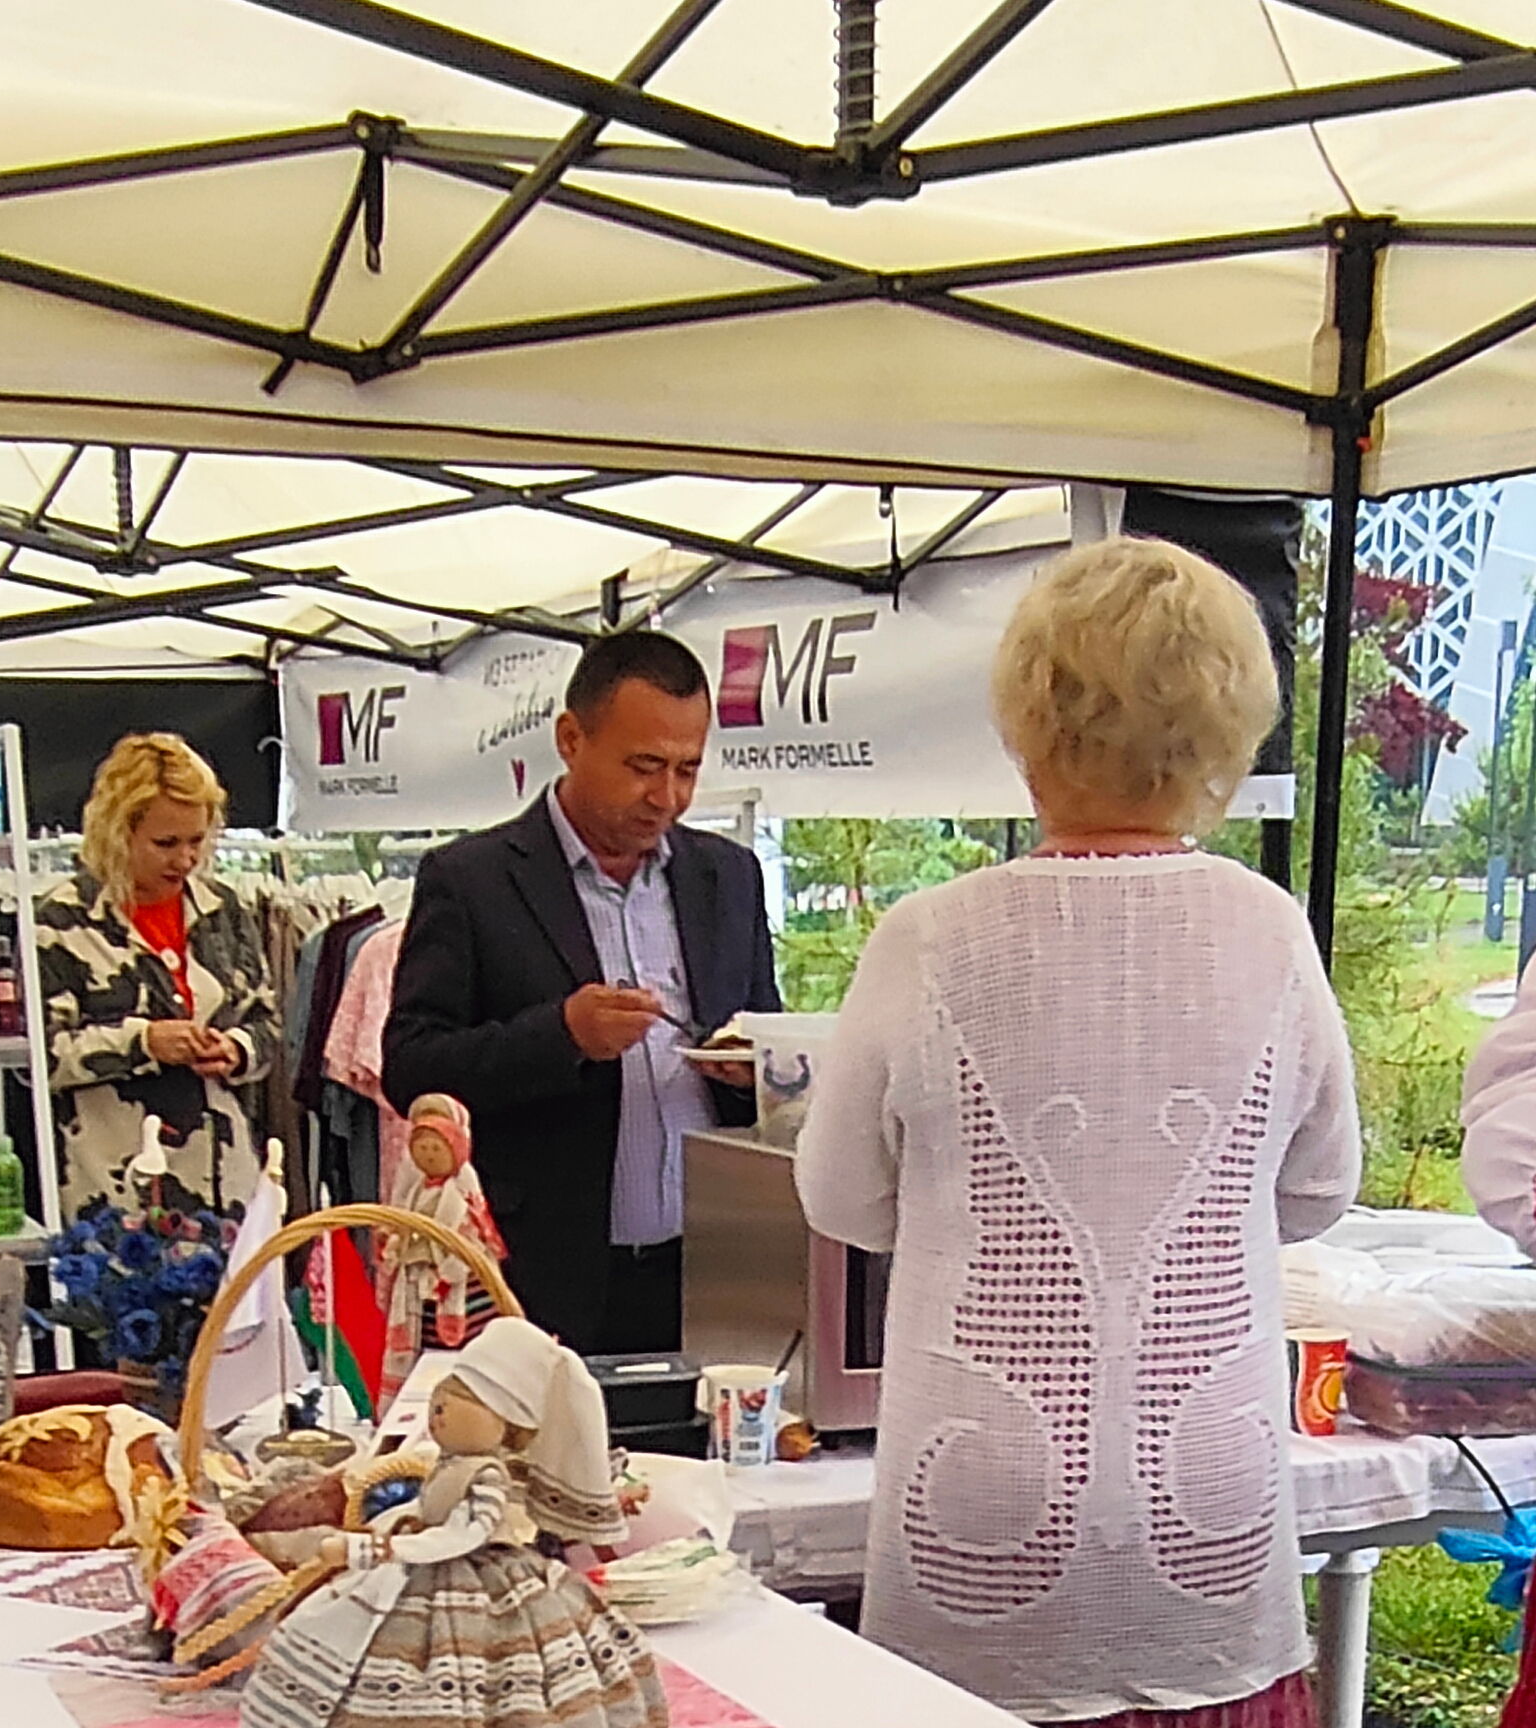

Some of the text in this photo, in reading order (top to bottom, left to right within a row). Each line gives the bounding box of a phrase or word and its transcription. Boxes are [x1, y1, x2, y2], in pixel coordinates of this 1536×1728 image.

[754, 610, 877, 726] MF
[334, 685, 406, 764] MF
[721, 741, 873, 770] MARK FORMELLE
